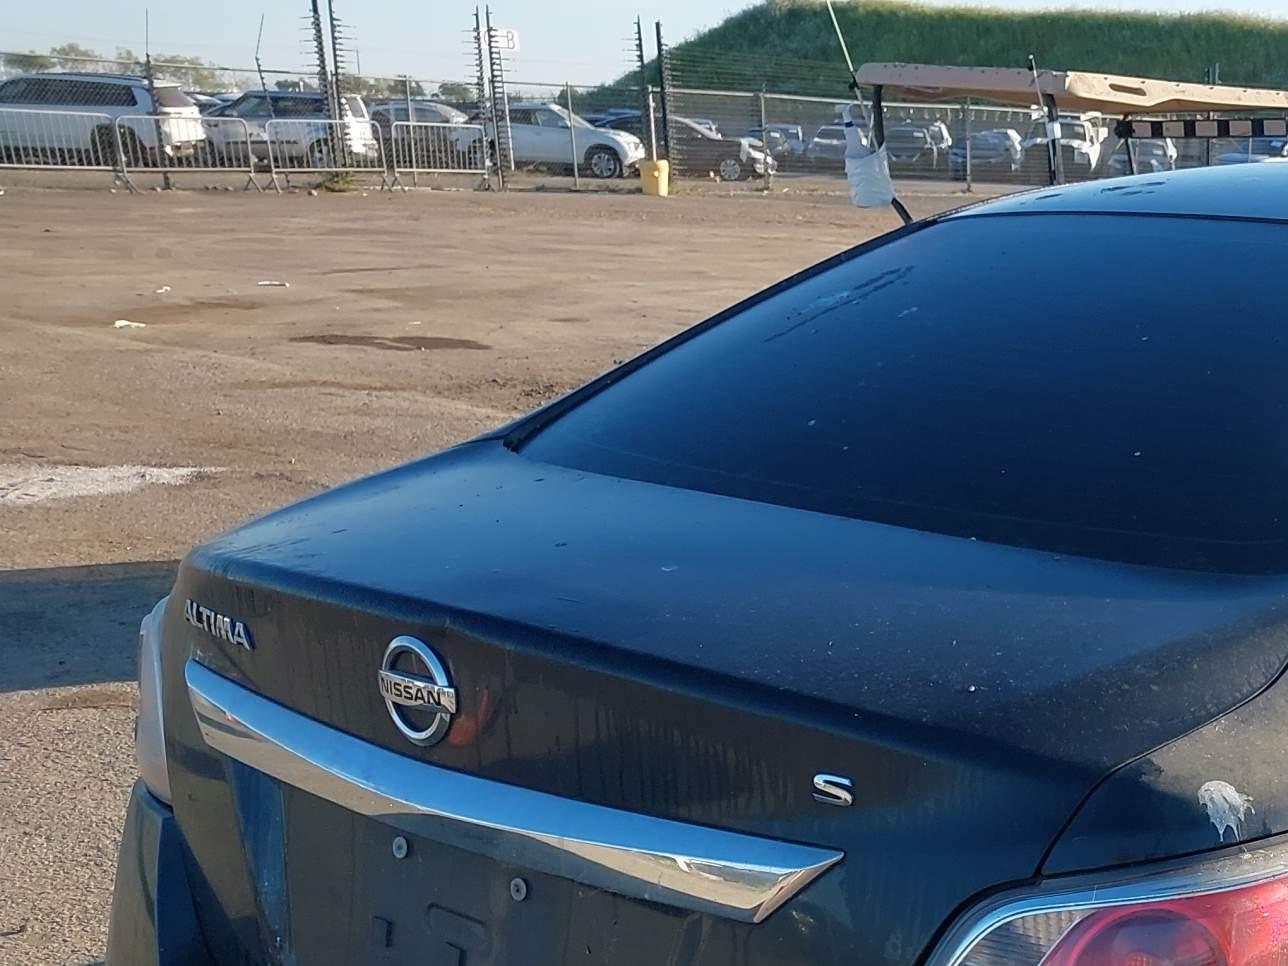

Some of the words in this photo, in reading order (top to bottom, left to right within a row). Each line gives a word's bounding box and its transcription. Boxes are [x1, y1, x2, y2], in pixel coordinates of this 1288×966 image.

[184, 599, 252, 651] ALTIMA
[380, 677, 442, 706] NISSAN
[812, 773, 853, 806] S
